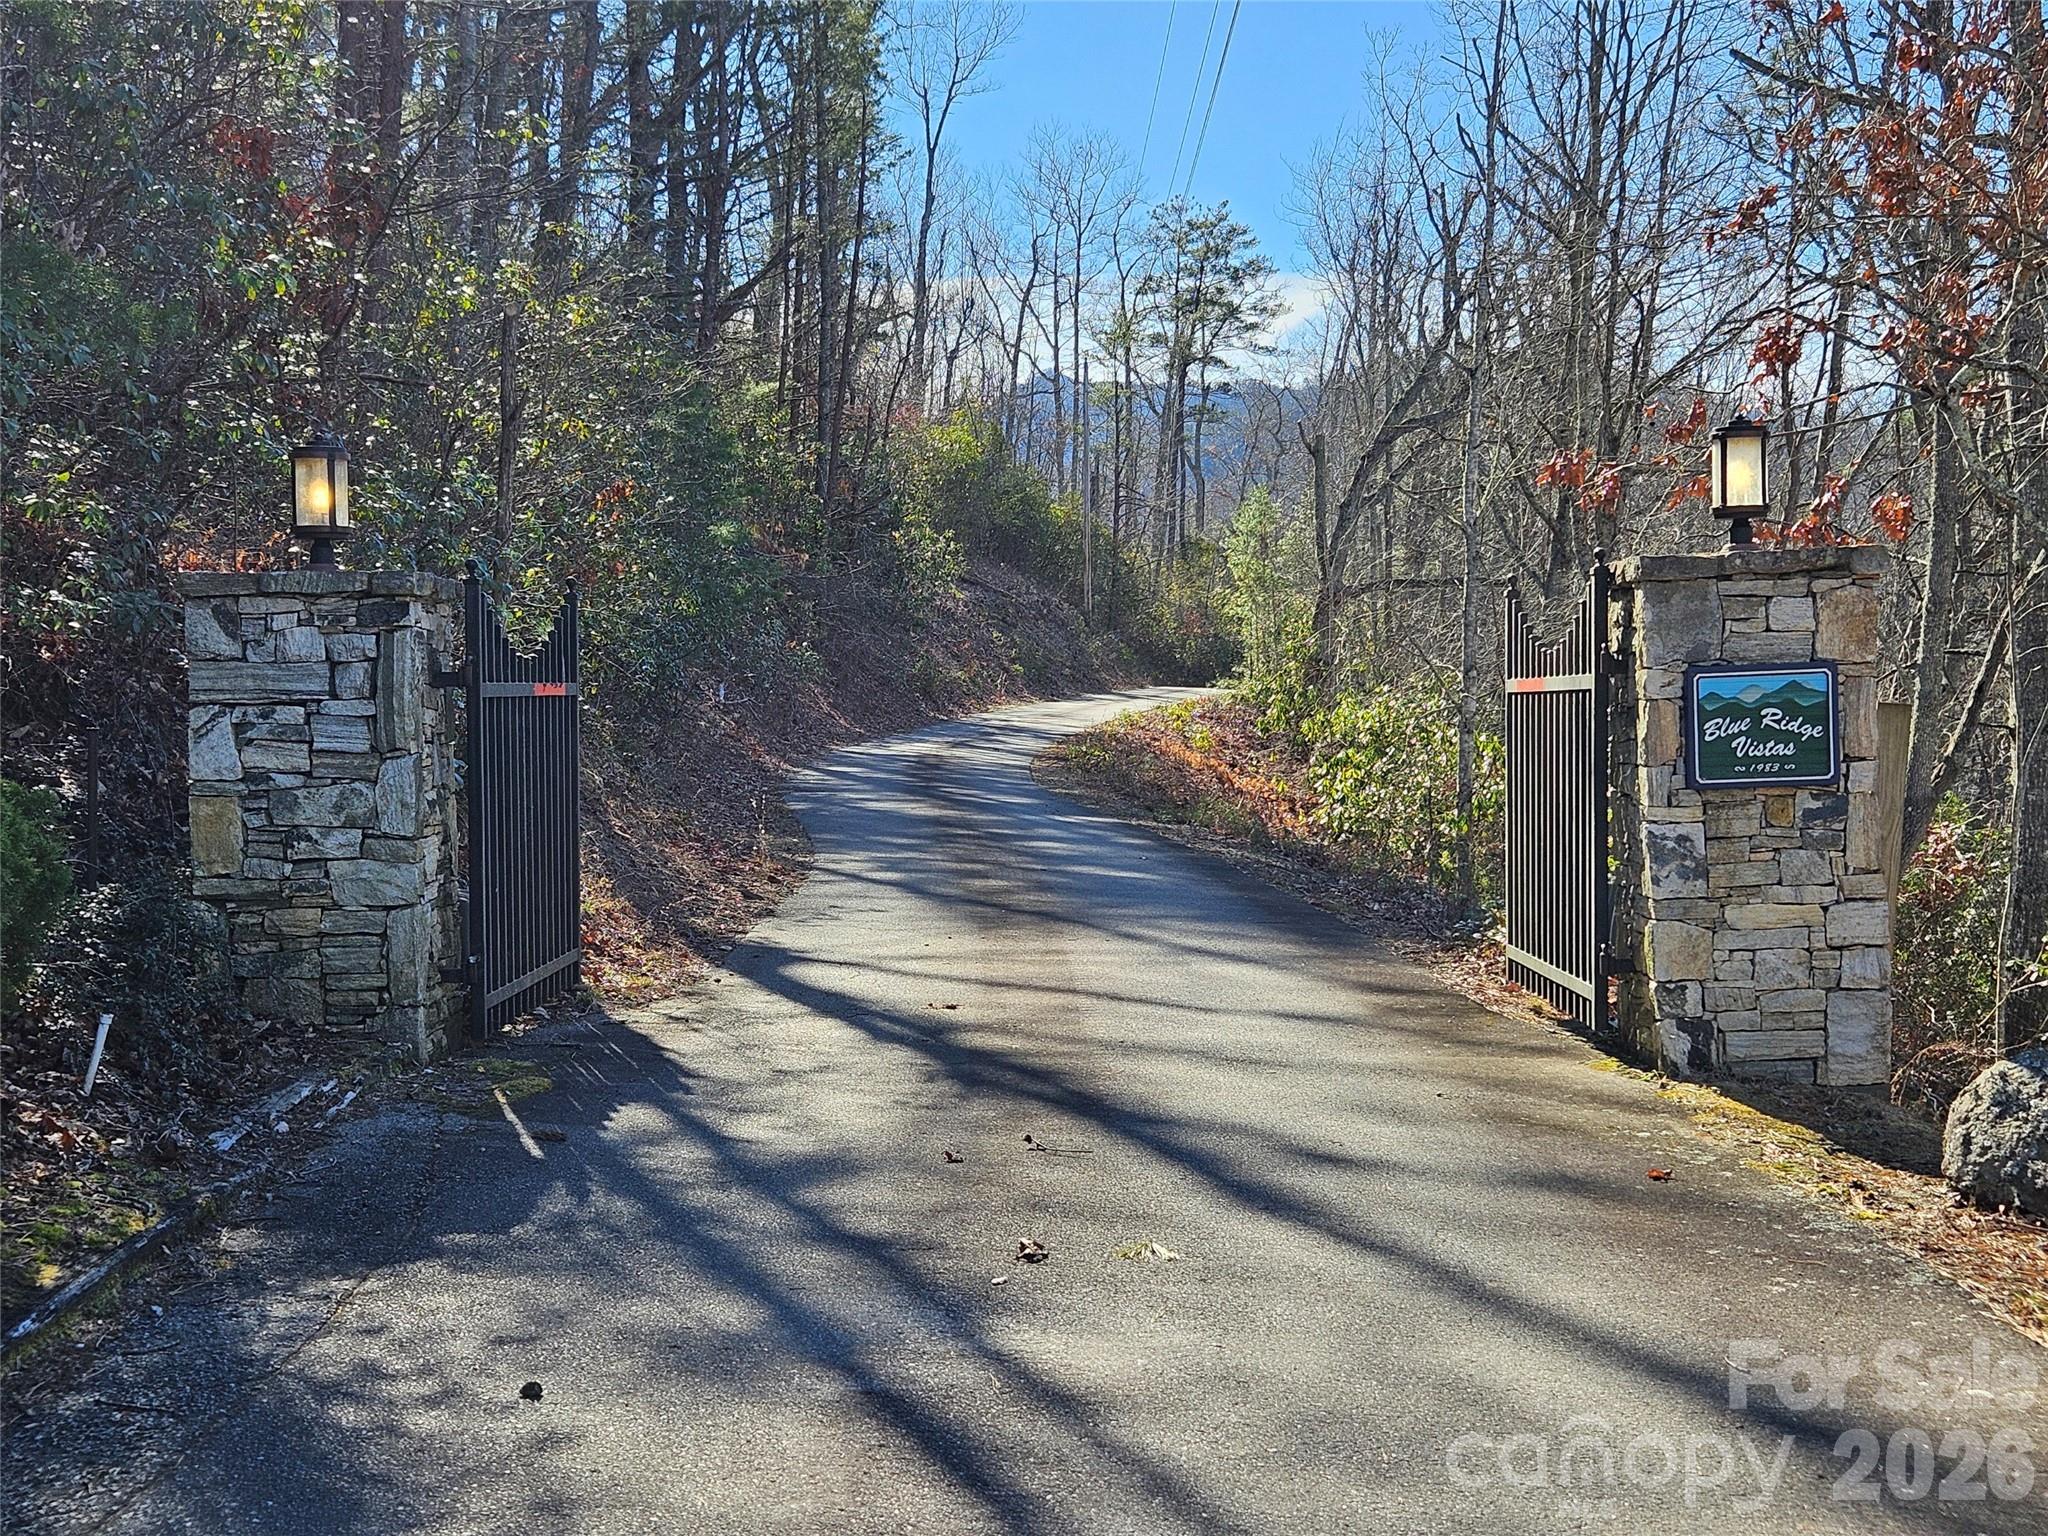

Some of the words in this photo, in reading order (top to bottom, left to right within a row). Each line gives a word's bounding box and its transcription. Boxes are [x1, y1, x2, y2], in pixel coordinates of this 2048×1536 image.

[1703, 717, 1752, 742] Blue
[1760, 707, 1824, 741] Ridge
[1731, 736, 1797, 758] Vistas
[1749, 763, 1780, 772] 1983
